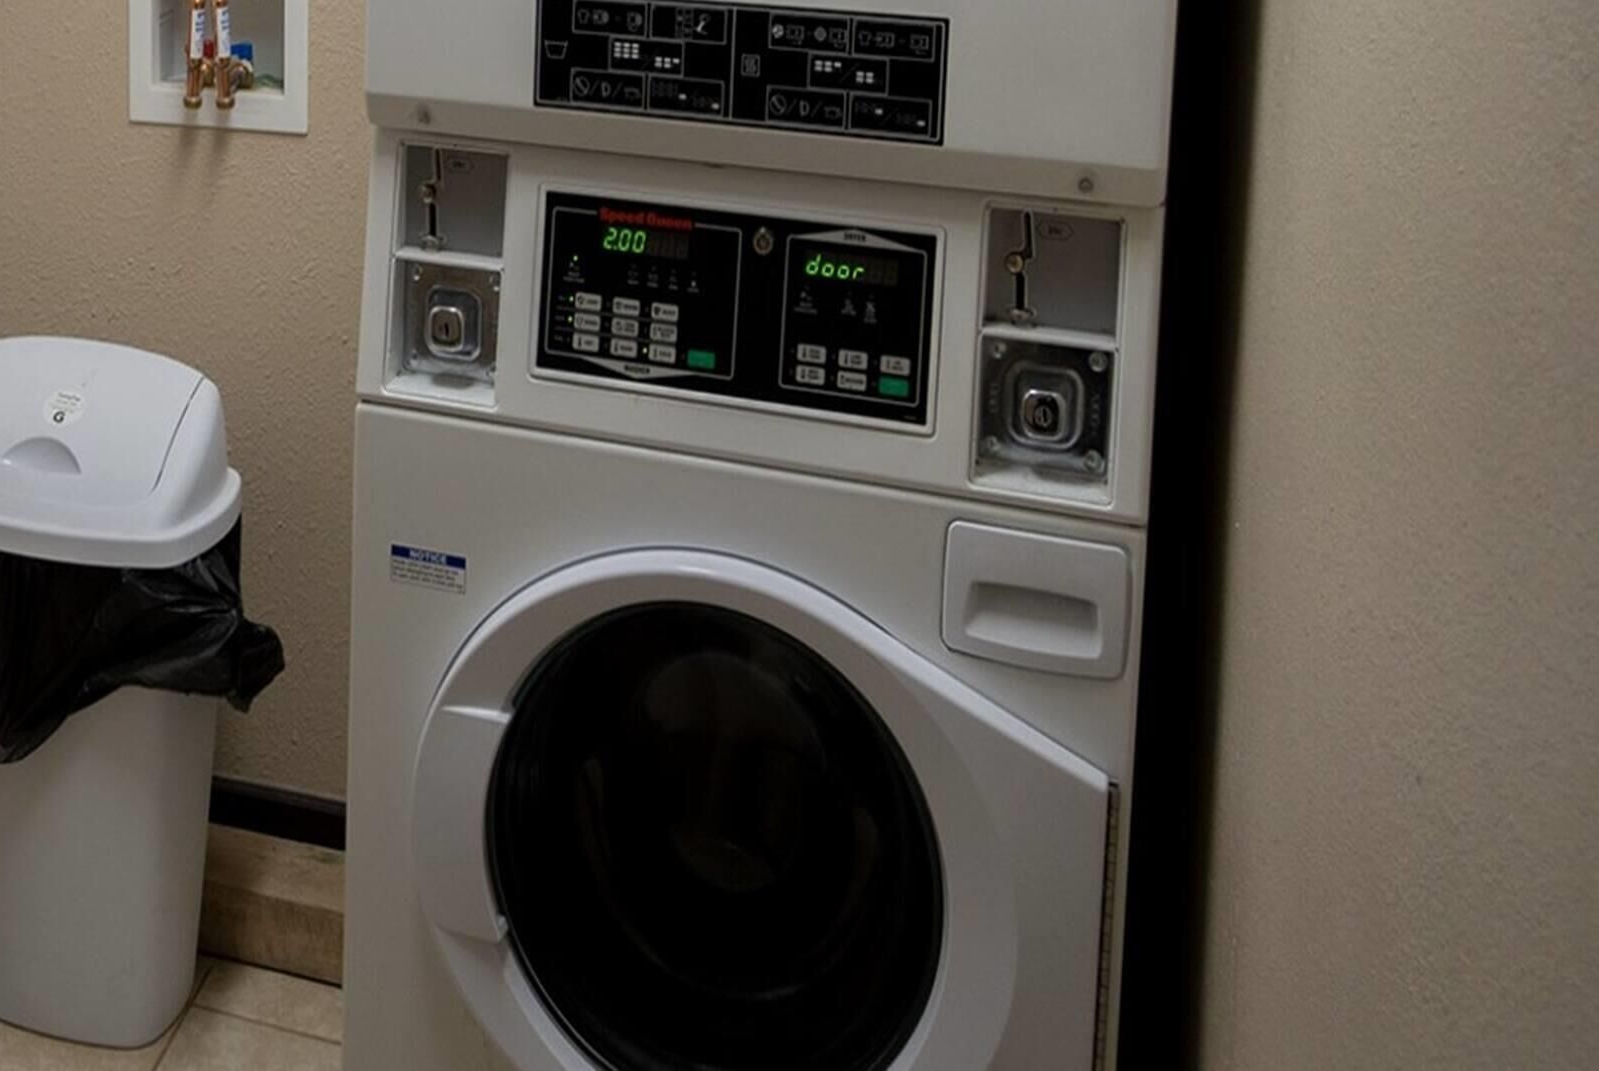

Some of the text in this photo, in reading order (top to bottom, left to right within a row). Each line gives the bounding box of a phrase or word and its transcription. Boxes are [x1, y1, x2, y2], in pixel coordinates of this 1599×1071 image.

[599, 208, 693, 230] Speed Queen
[603, 227, 647, 254] 2.00
[806, 253, 865, 280] door
[409, 548, 447, 565] NOTICE
